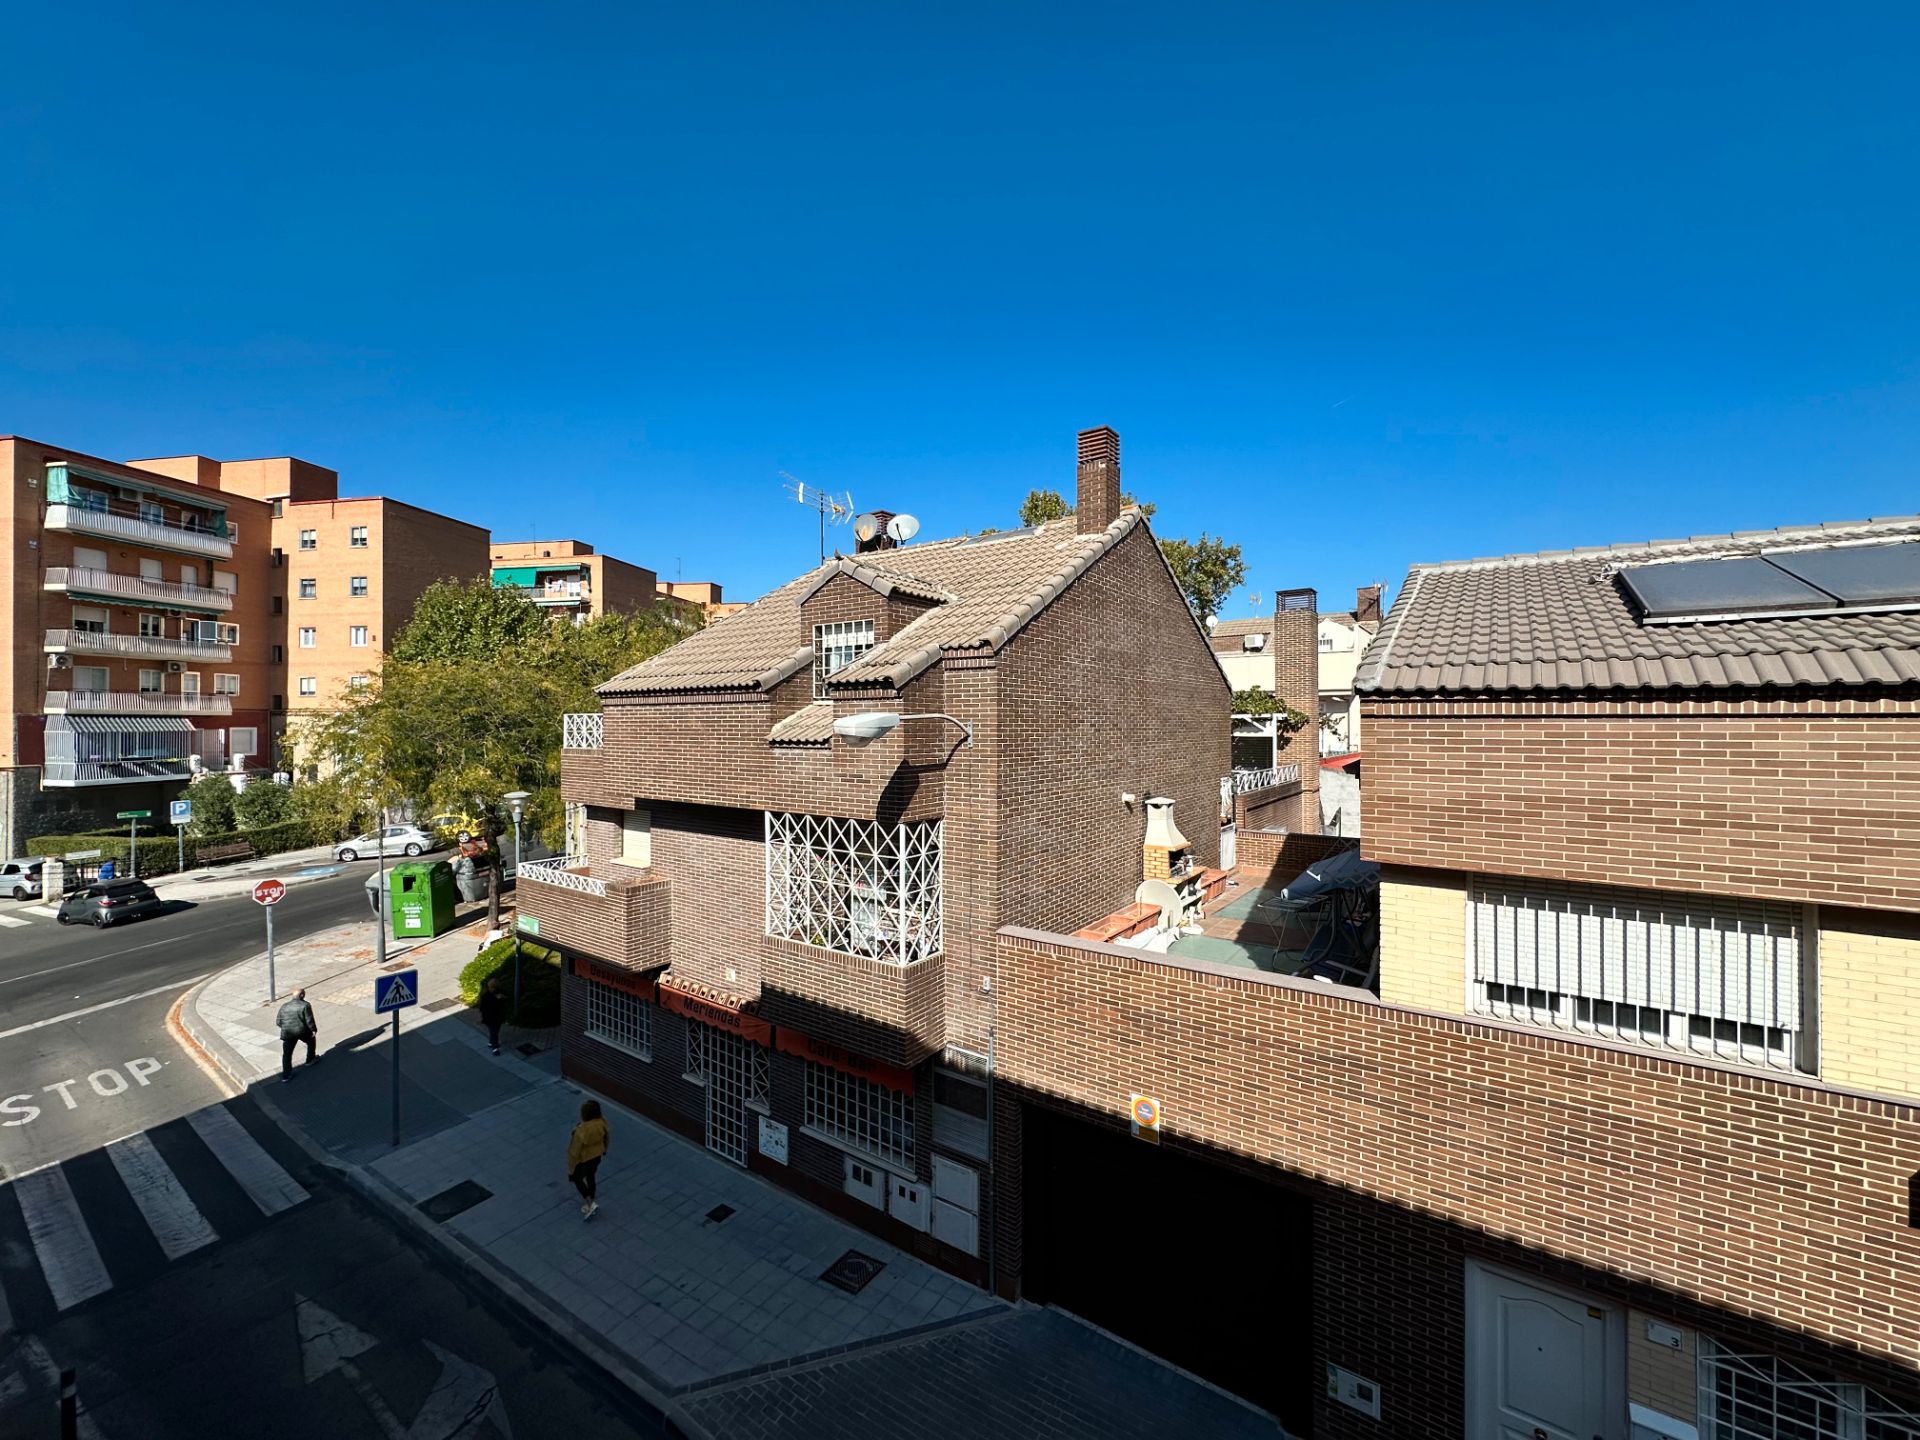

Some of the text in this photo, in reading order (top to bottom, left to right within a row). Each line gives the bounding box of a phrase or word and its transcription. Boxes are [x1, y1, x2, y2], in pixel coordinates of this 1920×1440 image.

[175, 803, 187, 814] P
[256, 886, 283, 897] STOP
[683, 995, 741, 1028] Meriendas
[0, 1057, 162, 1126] STOP
[1671, 1337, 1679, 1347] 3
